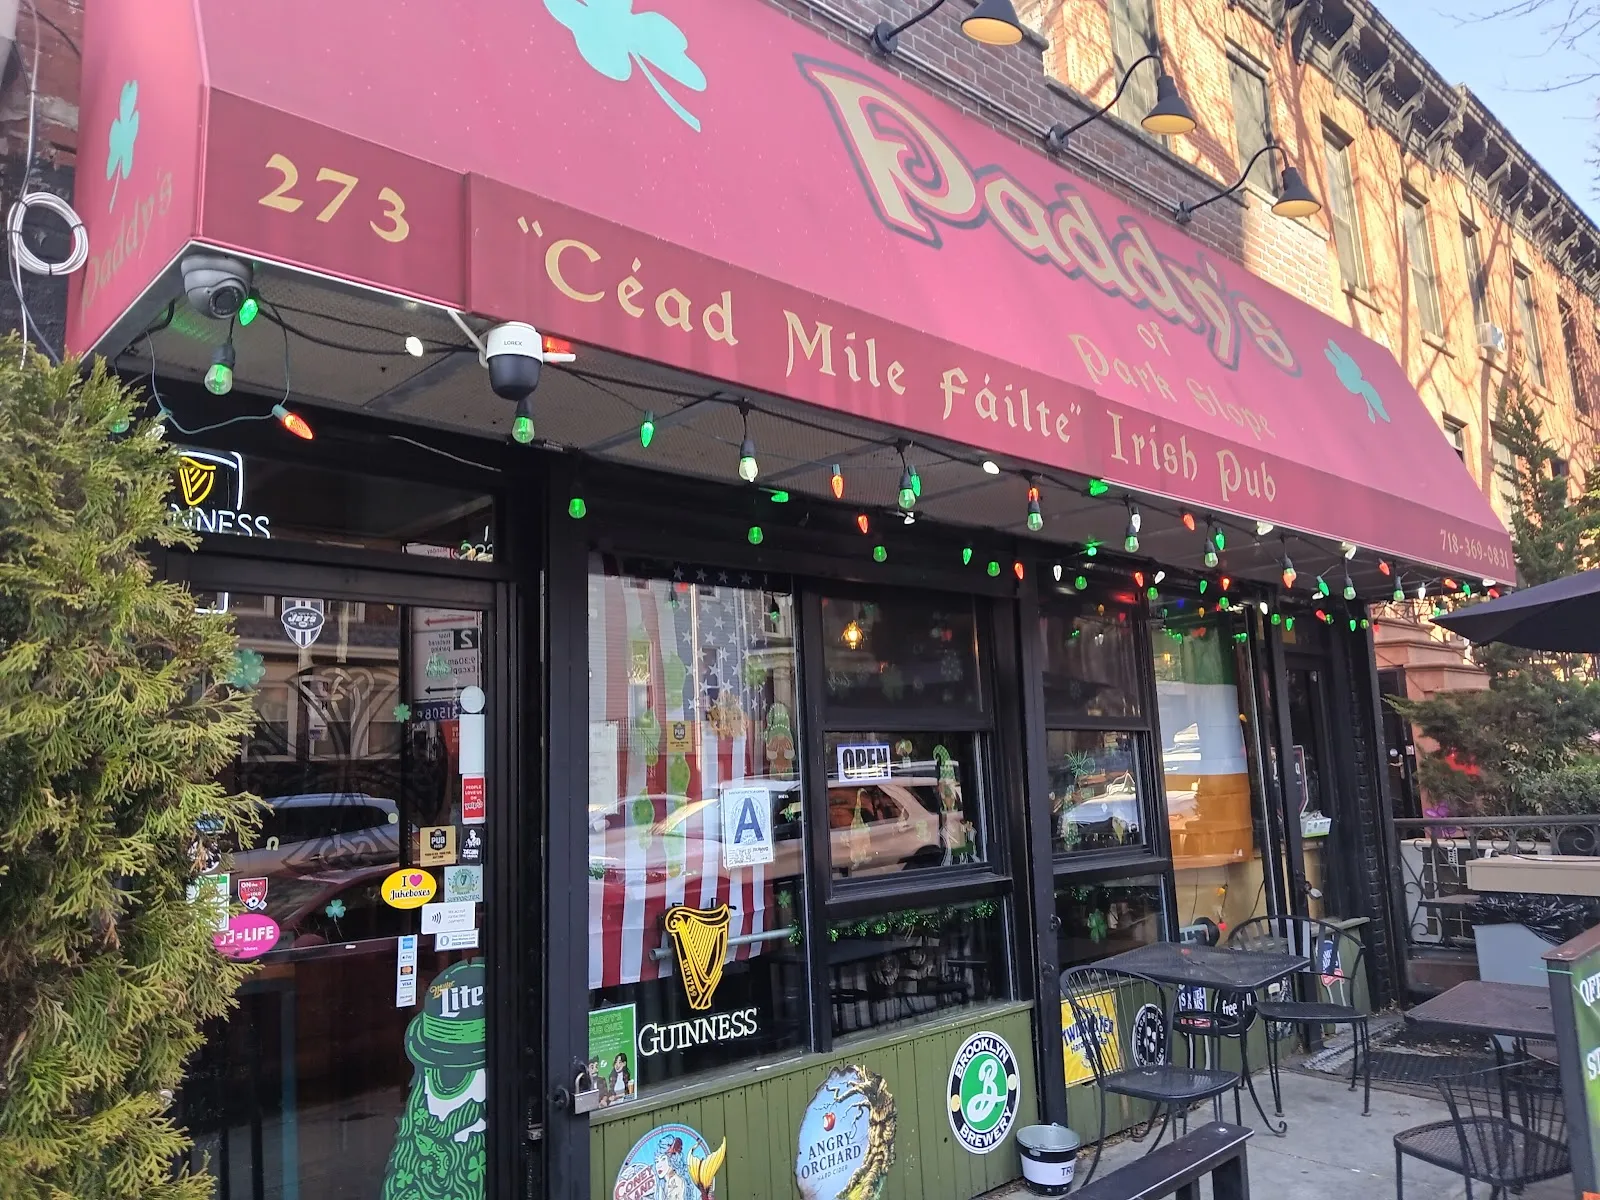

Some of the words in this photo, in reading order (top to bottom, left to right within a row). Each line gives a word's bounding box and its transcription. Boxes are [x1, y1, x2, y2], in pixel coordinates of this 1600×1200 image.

[258, 153, 410, 243] 273
[794, 52, 1302, 377] Paddy's
[1137, 321, 1171, 356] of
[1067, 334, 1178, 402] Park
[1186, 377, 1276, 440] Slope
[1106, 409, 1198, 481] Irish
[1216, 449, 1276, 502] Pub
[167, 503, 271, 540] NNESS
[1440, 528, 1509, 570] 718-369-0831
[843, 748, 889, 779] OPEN
[431, 836, 446, 845] PUB
[733, 797, 765, 845] A
[390, 889, 430, 901] Jukeboxes
[402, 875, 408, 888] I
[439, 985, 484, 1017] Lite
[638, 1007, 758, 1057] GUINNESS
[955, 1038, 1009, 1079] BROOKLYN
[808, 1131, 852, 1160] ANGRY
[960, 1106, 1012, 1147] BREWERY
[801, 1145, 861, 1179] ORCHARD
